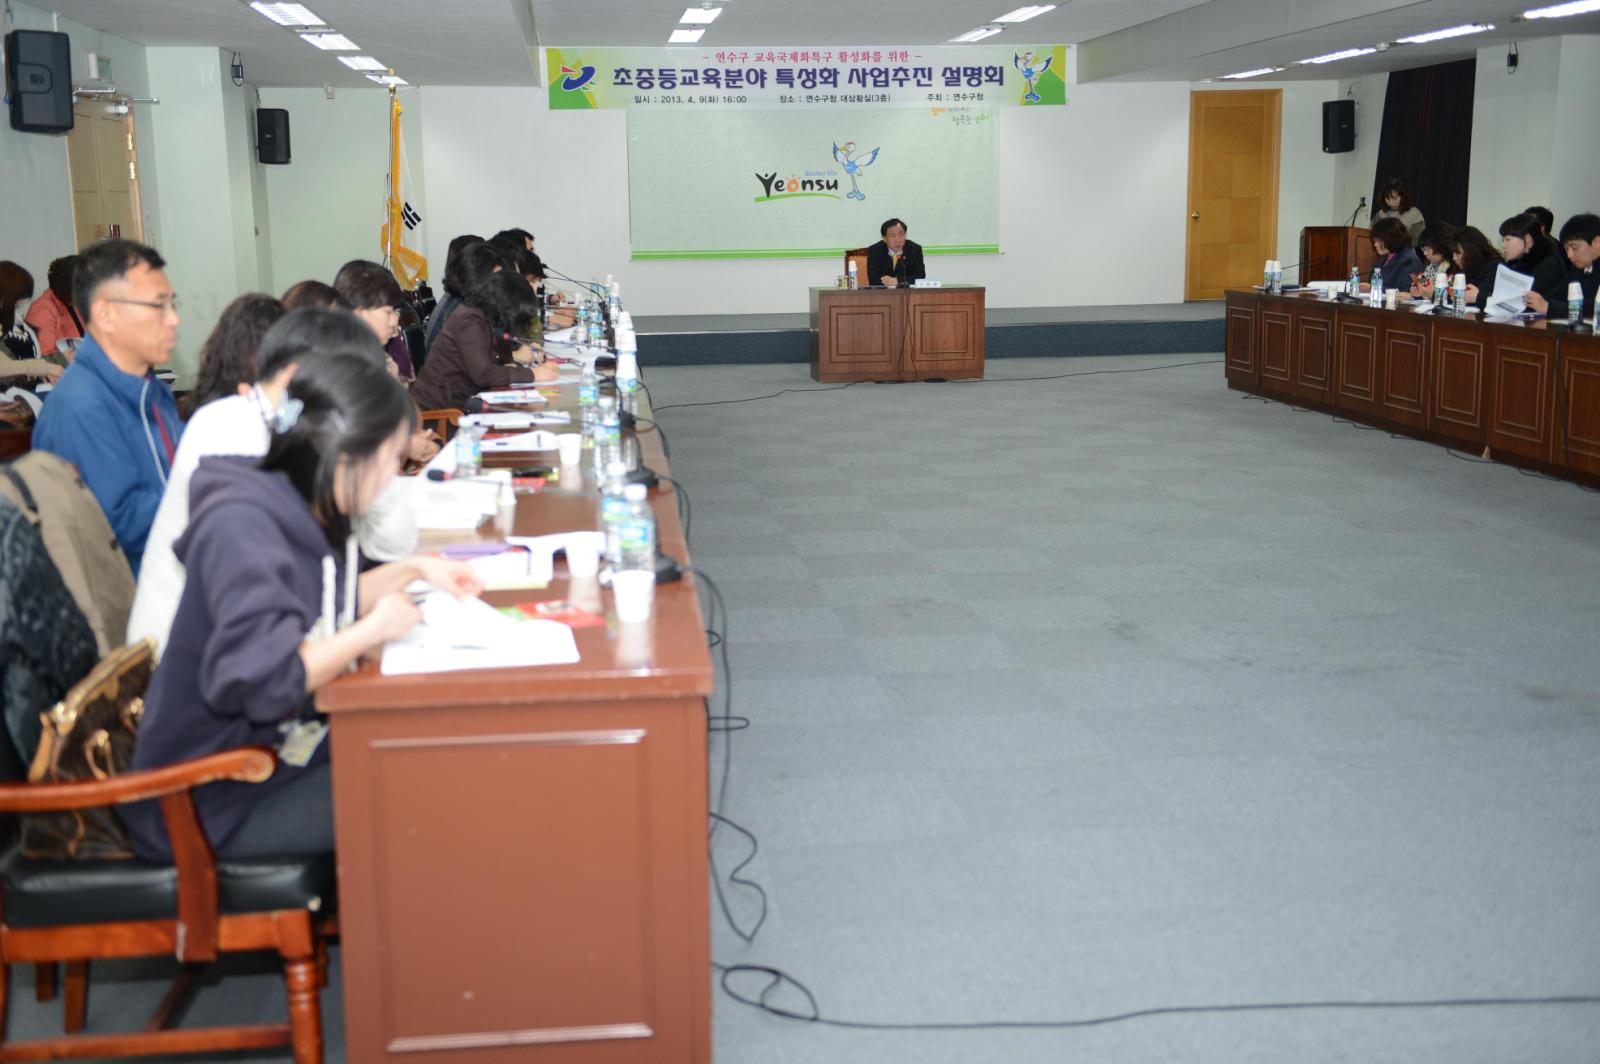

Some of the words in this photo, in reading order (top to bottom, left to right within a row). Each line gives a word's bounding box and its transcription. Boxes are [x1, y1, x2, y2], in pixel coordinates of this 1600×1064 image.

[715, 51, 748, 64] 연수구
[754, 51, 833, 63] 교육국제화특구
[838, 50, 882, 63] 활성화를
[887, 50, 910, 63] 위한
[612, 67, 768, 90] 초중등교육분야
[775, 67, 840, 90] 특성화
[847, 66, 933, 88] 사업추진
[941, 65, 1004, 88] 설명회
[633, 95, 650, 104] 일시
[660, 95, 684, 104] 2013.
[698, 95, 719, 104] 9(화)
[722, 95, 747, 104] 16:00
[779, 95, 795, 104] 장소
[805, 94, 837, 103] 연수구청
[927, 93, 942, 102] 주최
[952, 92, 984, 102] 연수구청
[754, 172, 839, 198] Yeonsu
